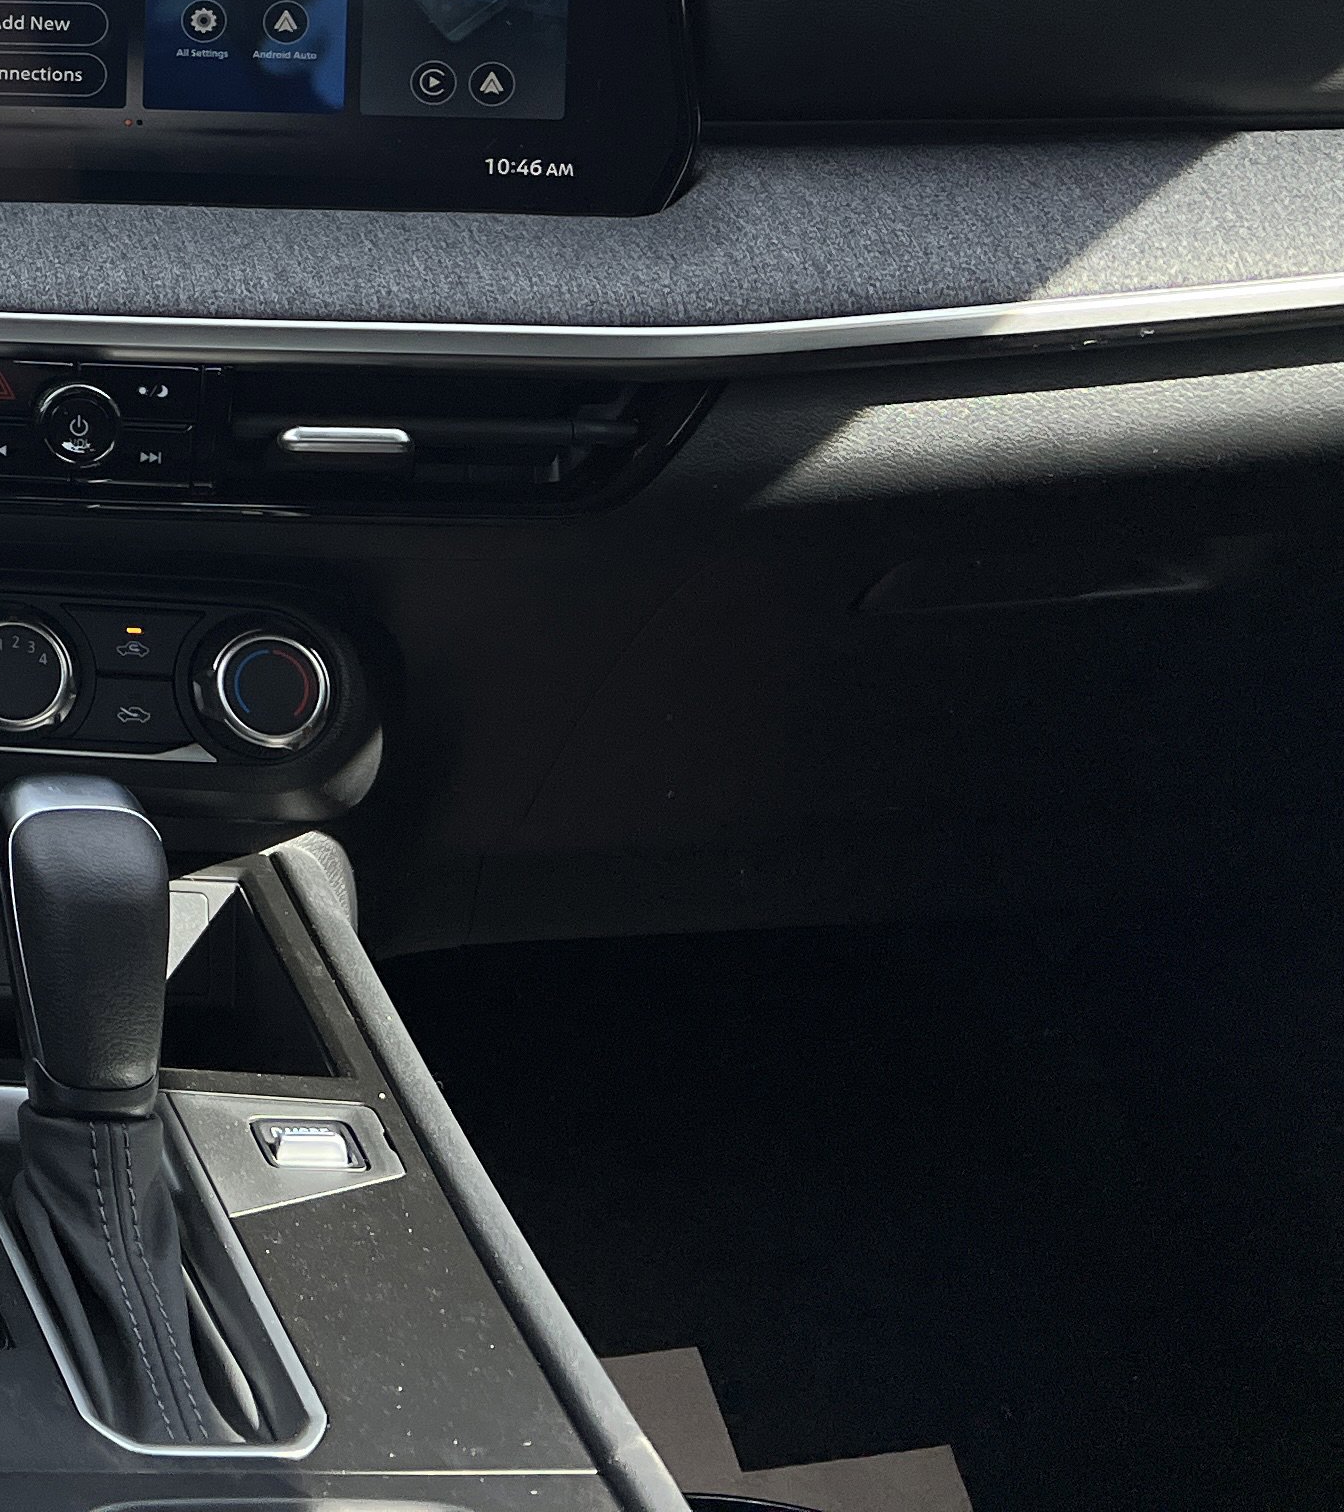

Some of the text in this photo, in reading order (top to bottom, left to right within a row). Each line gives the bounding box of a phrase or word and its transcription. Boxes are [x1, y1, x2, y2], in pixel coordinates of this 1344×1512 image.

[23, 15, 71, 32] New
[176, 48, 229, 60] All Settings
[252, 49, 318, 59] Android Auto
[483, 157, 575, 178] 10:46 AM
[11, 635, 20, 649] 2
[27, 640, 36, 654] 3
[38, 652, 48, 665] 4
